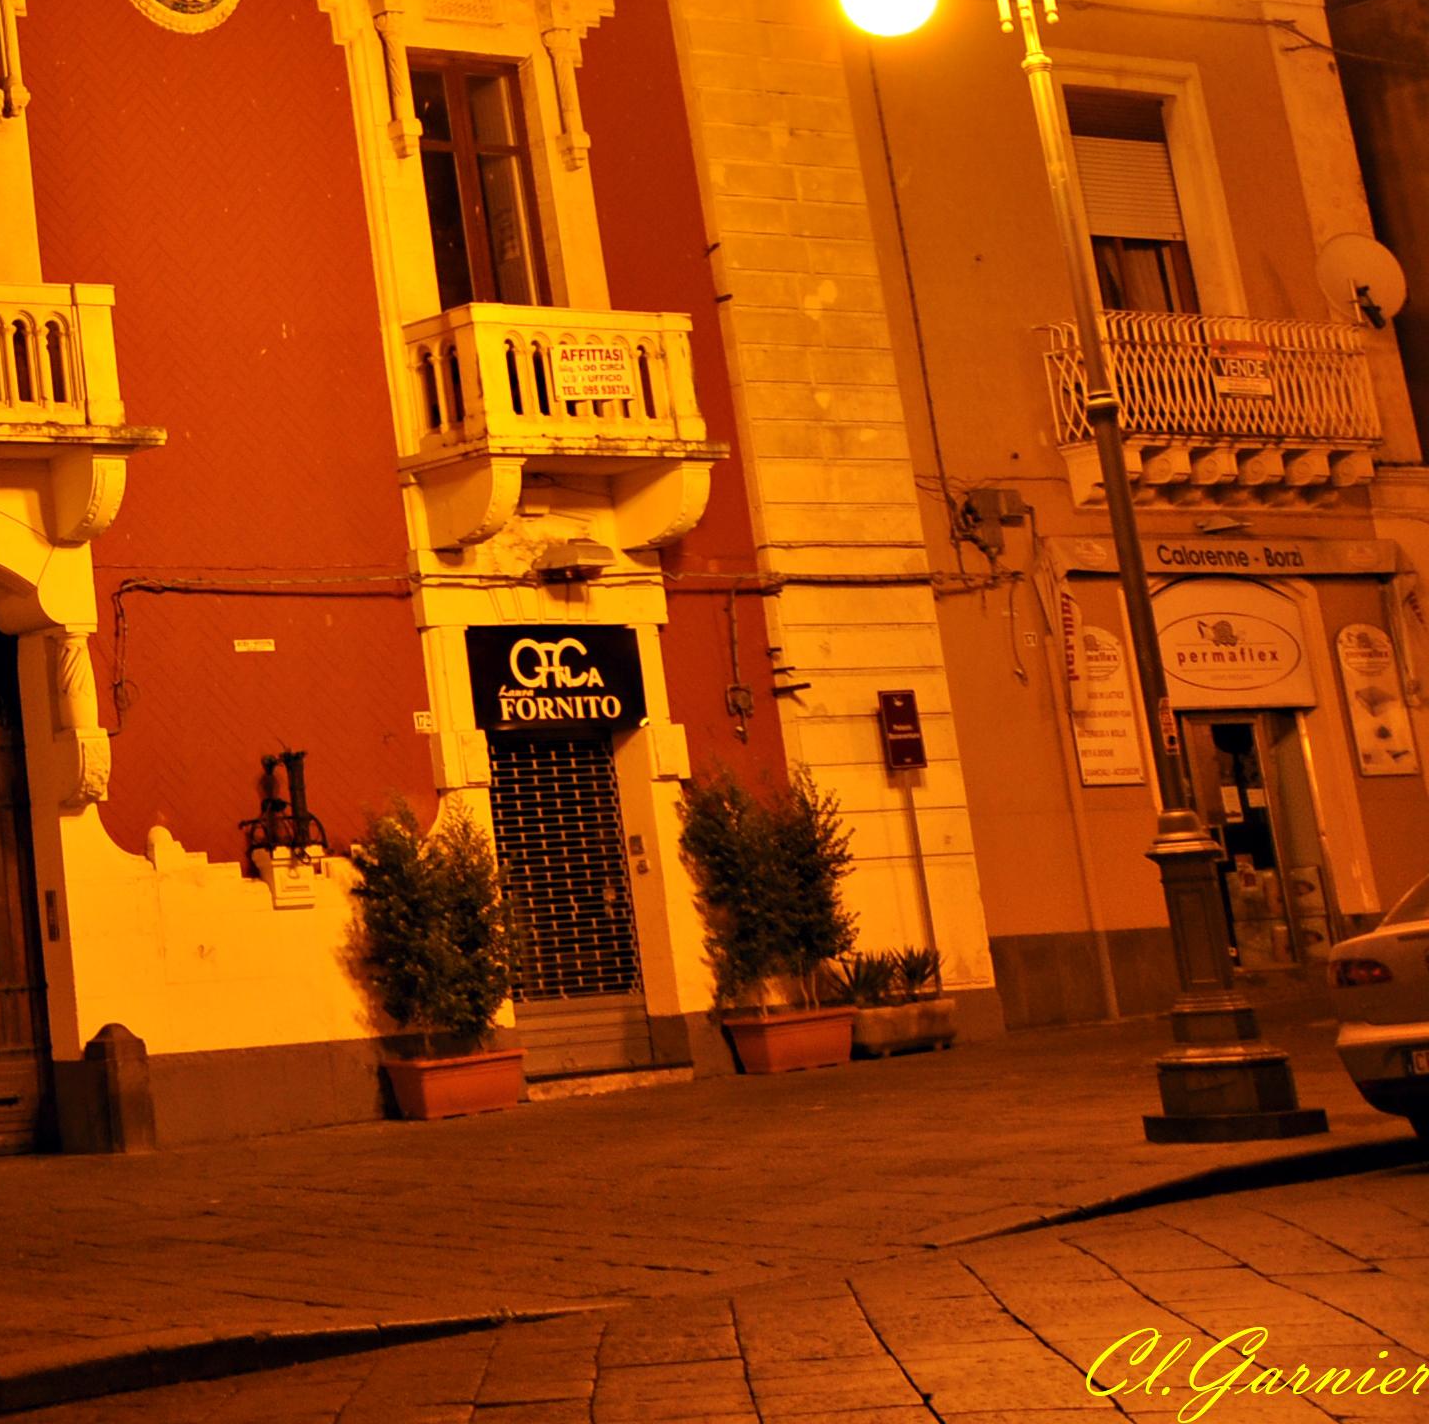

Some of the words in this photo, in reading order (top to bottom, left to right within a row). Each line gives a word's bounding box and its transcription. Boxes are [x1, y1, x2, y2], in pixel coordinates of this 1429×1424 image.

[561, 349, 623, 362] AFFITTASI
[1219, 359, 1265, 378] VENDE
[1157, 544, 1250, 567] Calorenne
[1177, 647, 1279, 667] permaflex
[499, 695, 622, 722] FORNITO
